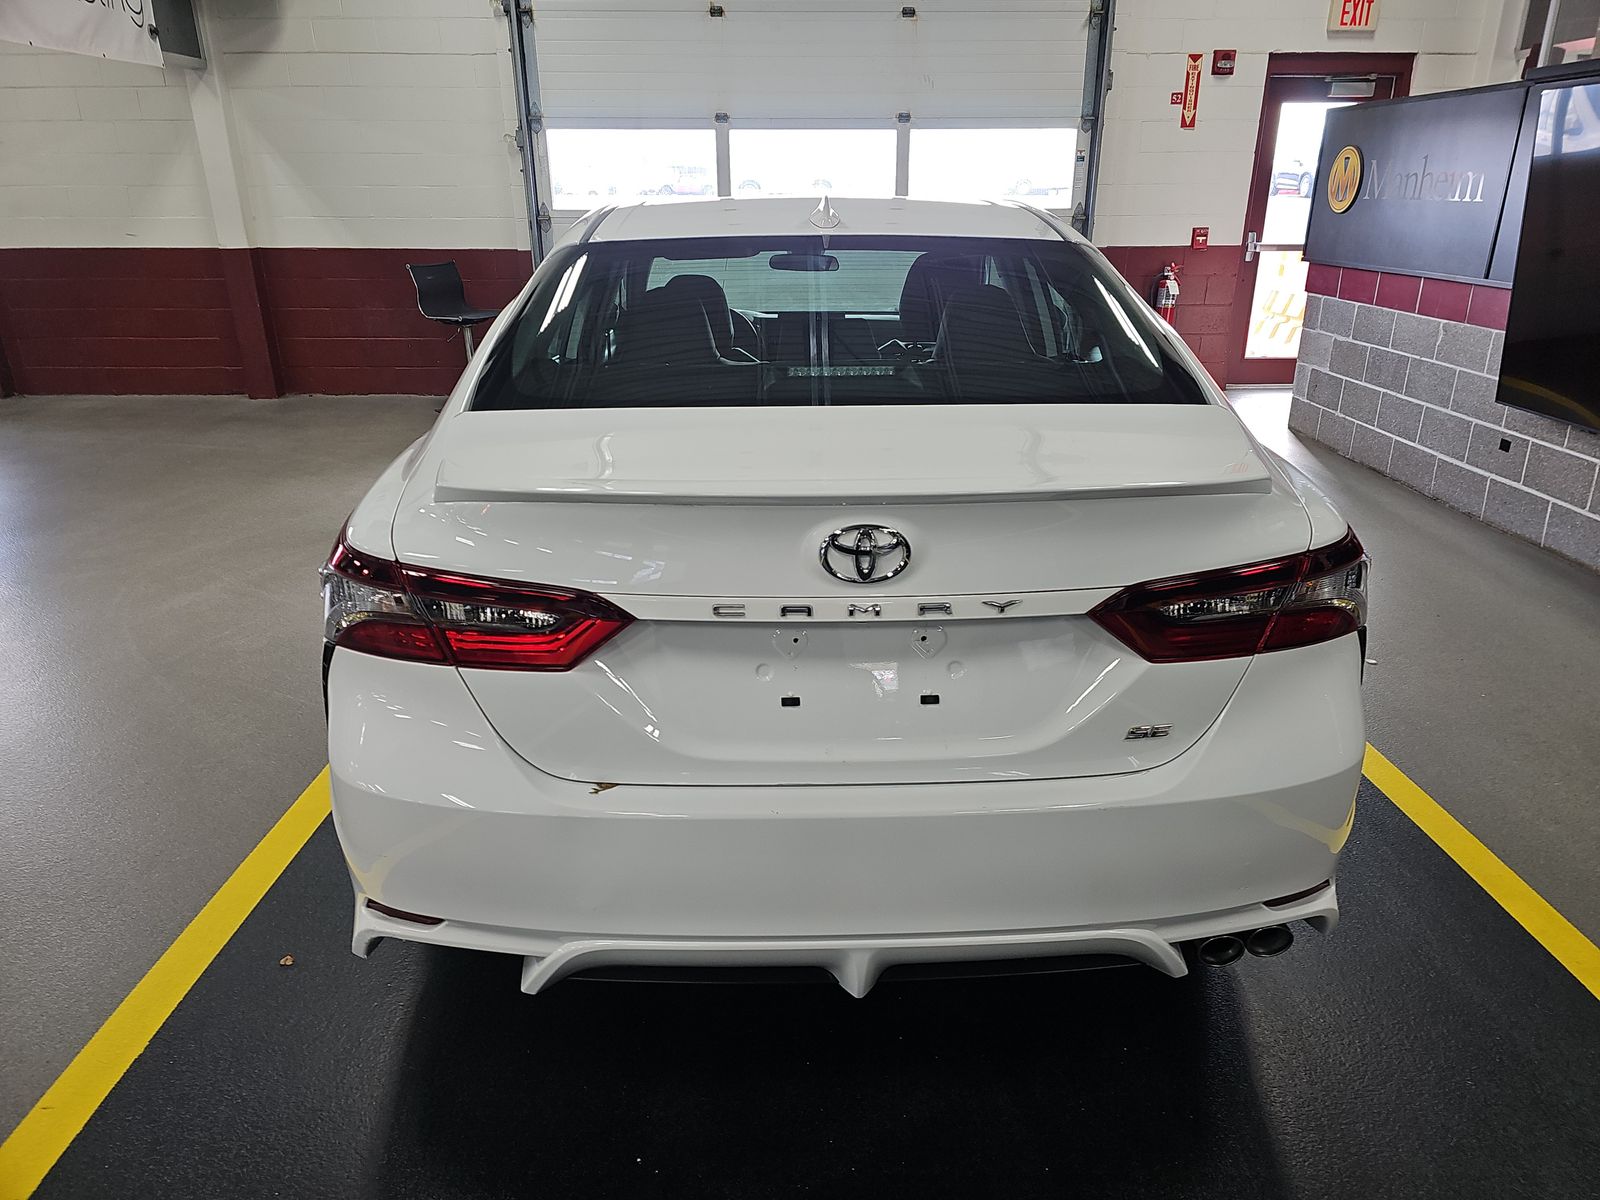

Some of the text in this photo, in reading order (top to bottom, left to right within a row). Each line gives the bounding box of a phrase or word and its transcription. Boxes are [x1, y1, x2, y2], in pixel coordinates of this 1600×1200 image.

[1340, 0, 1374, 26] EXIT
[712, 600, 1023, 617] CAMRY
[1124, 723, 1173, 740] SE
